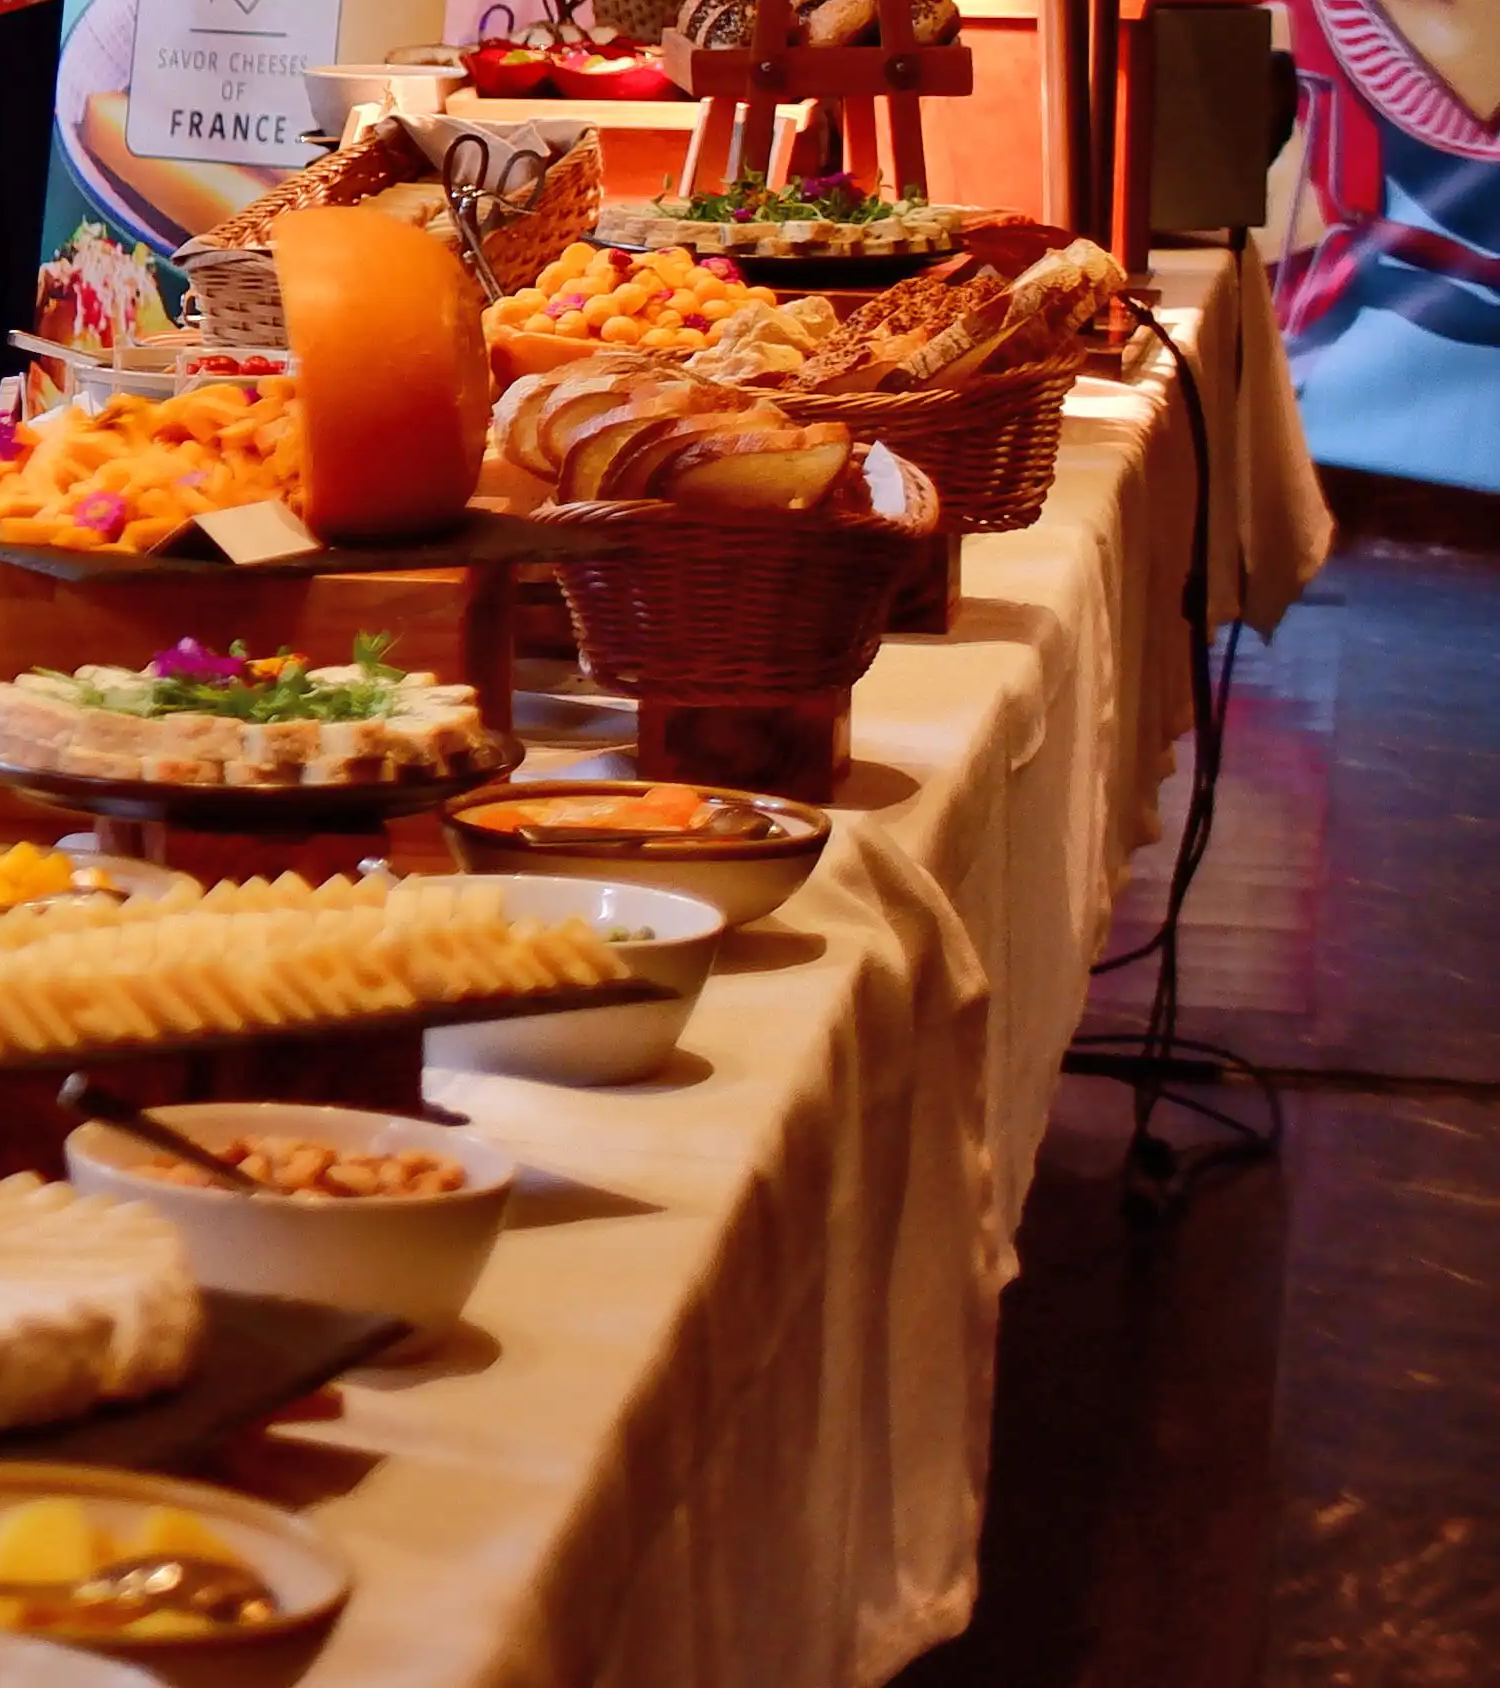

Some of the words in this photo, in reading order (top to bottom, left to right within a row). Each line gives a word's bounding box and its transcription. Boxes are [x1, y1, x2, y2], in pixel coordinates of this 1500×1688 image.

[157, 47, 219, 75] SAVOR
[228, 51, 308, 77] CHEESES
[221, 79, 248, 102] OF
[169, 109, 287, 145] FRANCE
